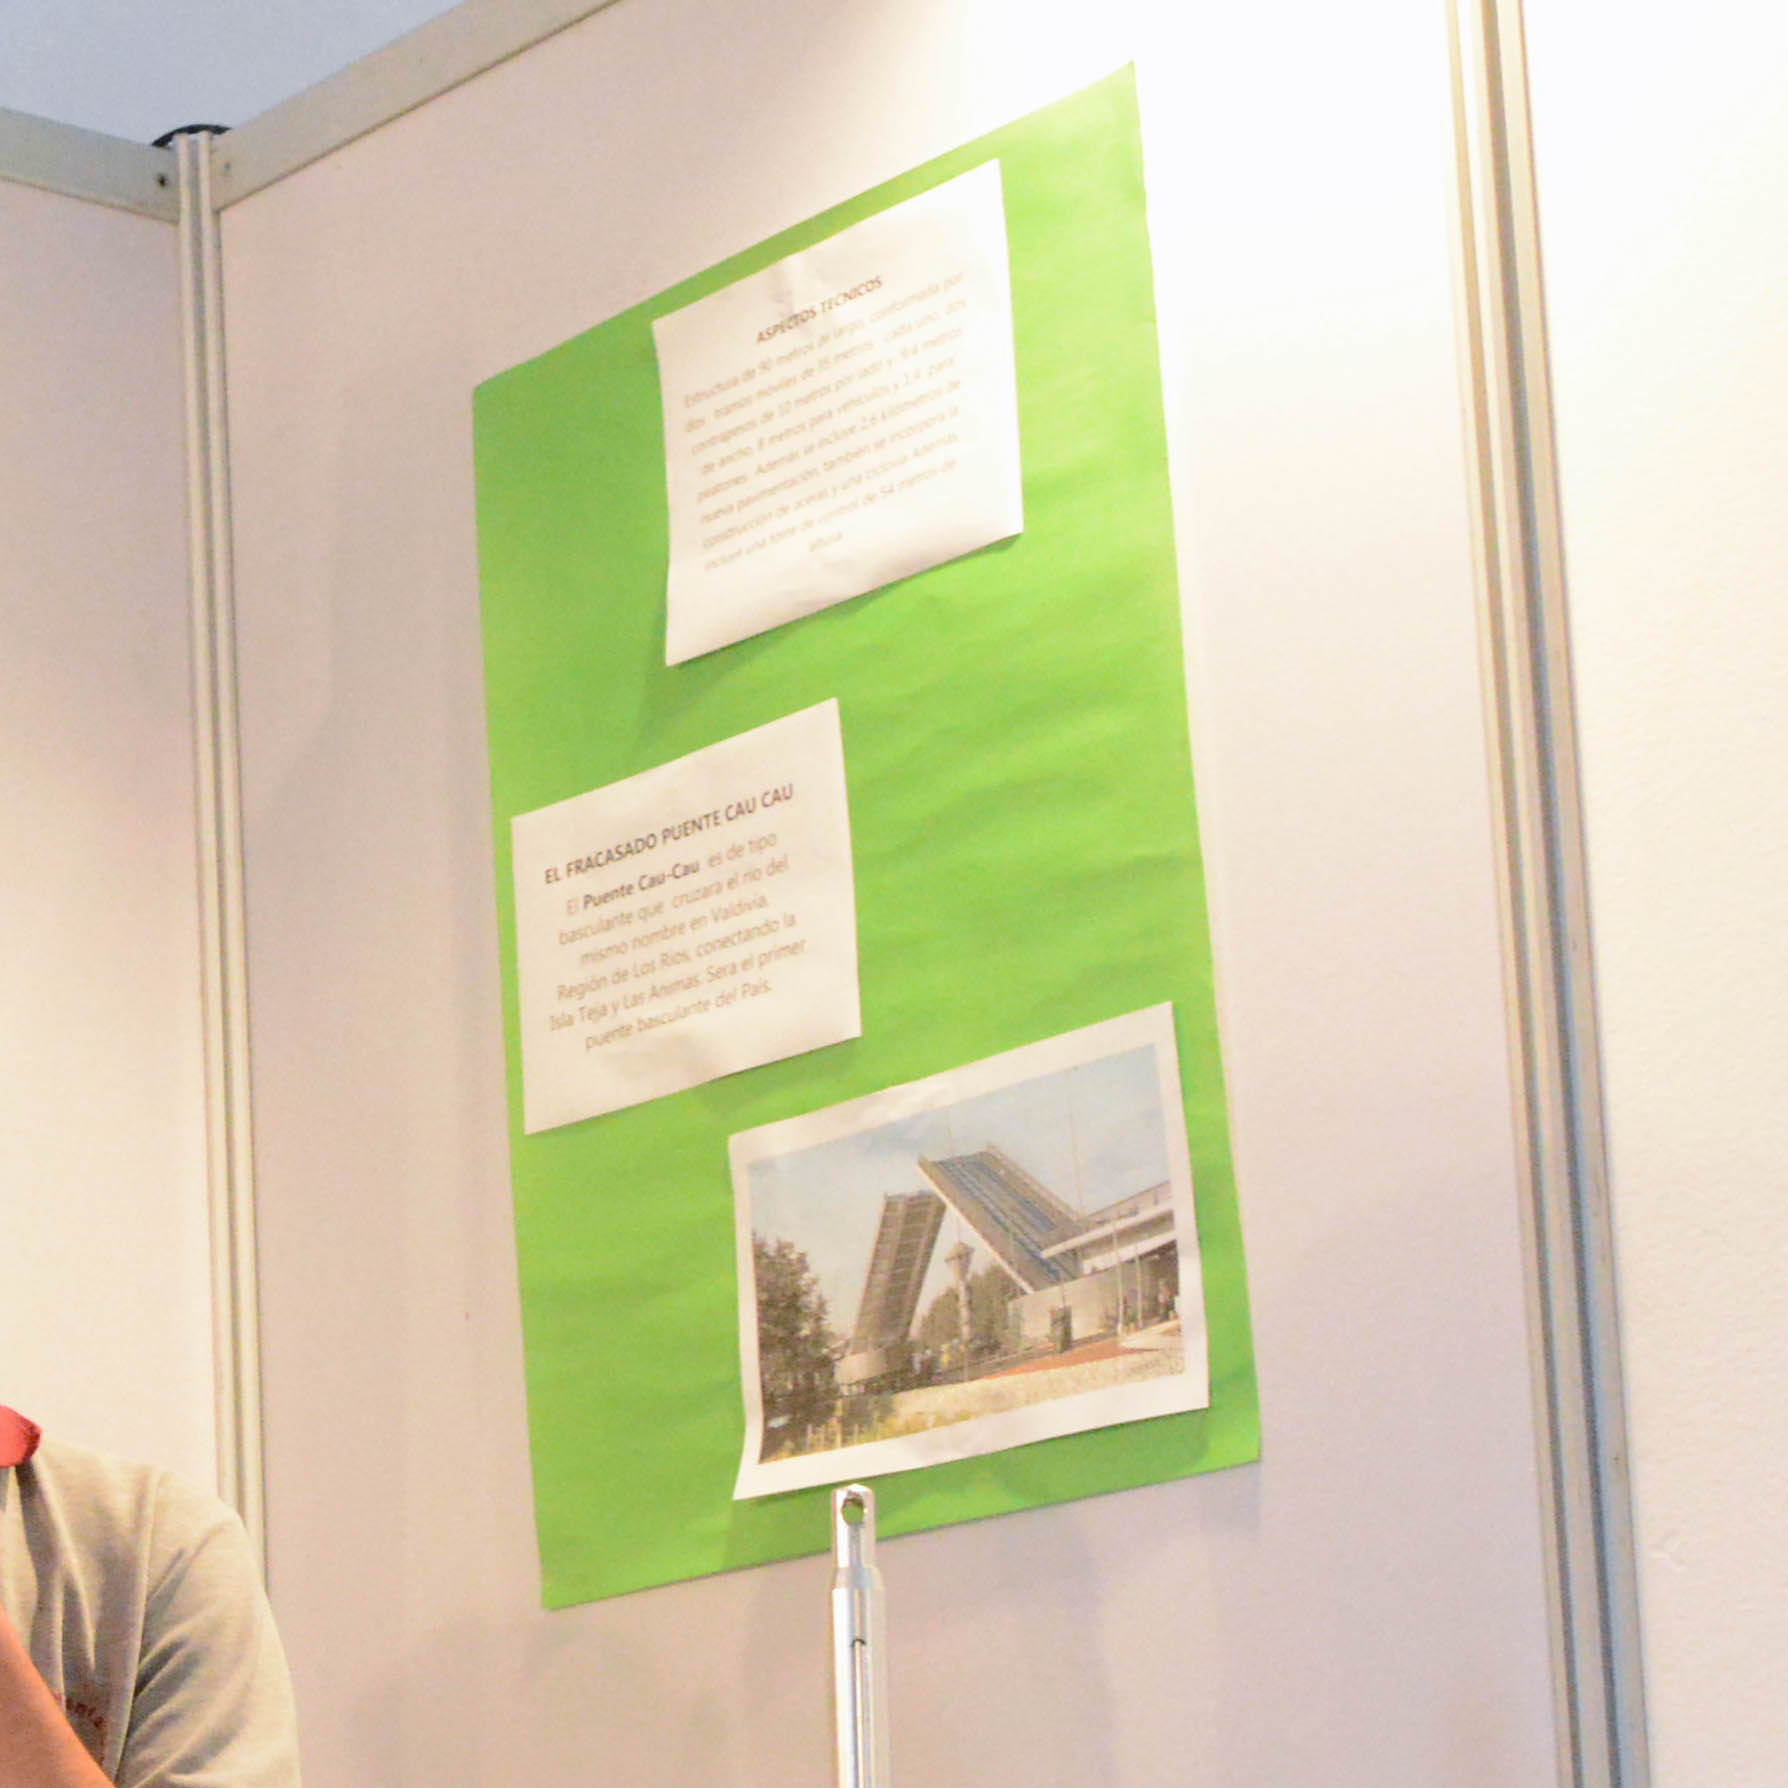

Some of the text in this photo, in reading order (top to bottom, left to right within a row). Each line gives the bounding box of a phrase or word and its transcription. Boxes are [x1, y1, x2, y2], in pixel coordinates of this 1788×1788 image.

[756, 308, 816, 345] ASPECTOS
[544, 782, 794, 885] EL FRACASADO PUENTE CAU CAU
[558, 910, 633, 946] basculante
[637, 900, 665, 923] que
[766, 852, 791, 877] del
[583, 882, 634, 910] Puente
[638, 859, 700, 892] Cau-Cau
[726, 843, 746, 861] de
[747, 831, 778, 855] tipo
[632, 920, 686, 950] nombre
[689, 914, 708, 933] en
[611, 967, 629, 985] de
